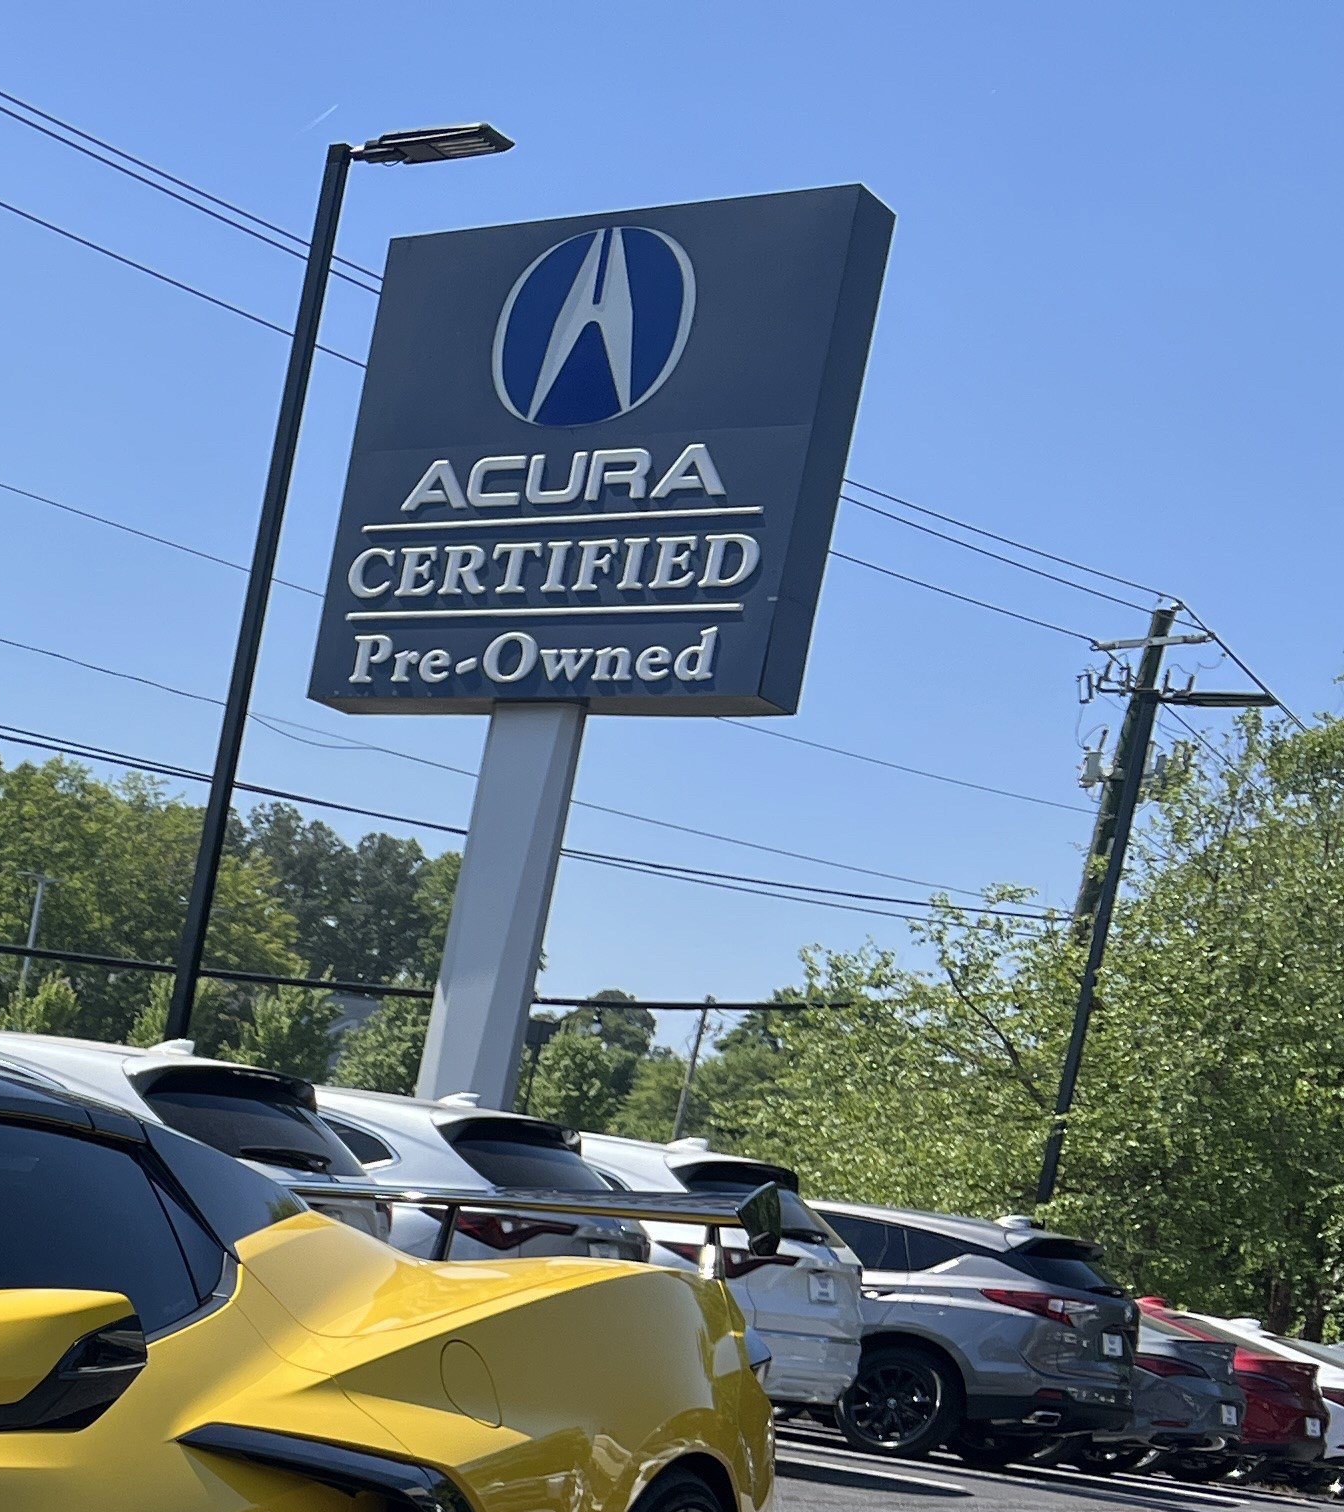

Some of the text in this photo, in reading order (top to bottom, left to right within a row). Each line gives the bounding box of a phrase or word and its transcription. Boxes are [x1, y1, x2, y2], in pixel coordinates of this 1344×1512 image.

[400, 443, 727, 512] ACURA
[347, 532, 761, 600] CERTIFIED
[348, 626, 718, 684] Pre-Owned
